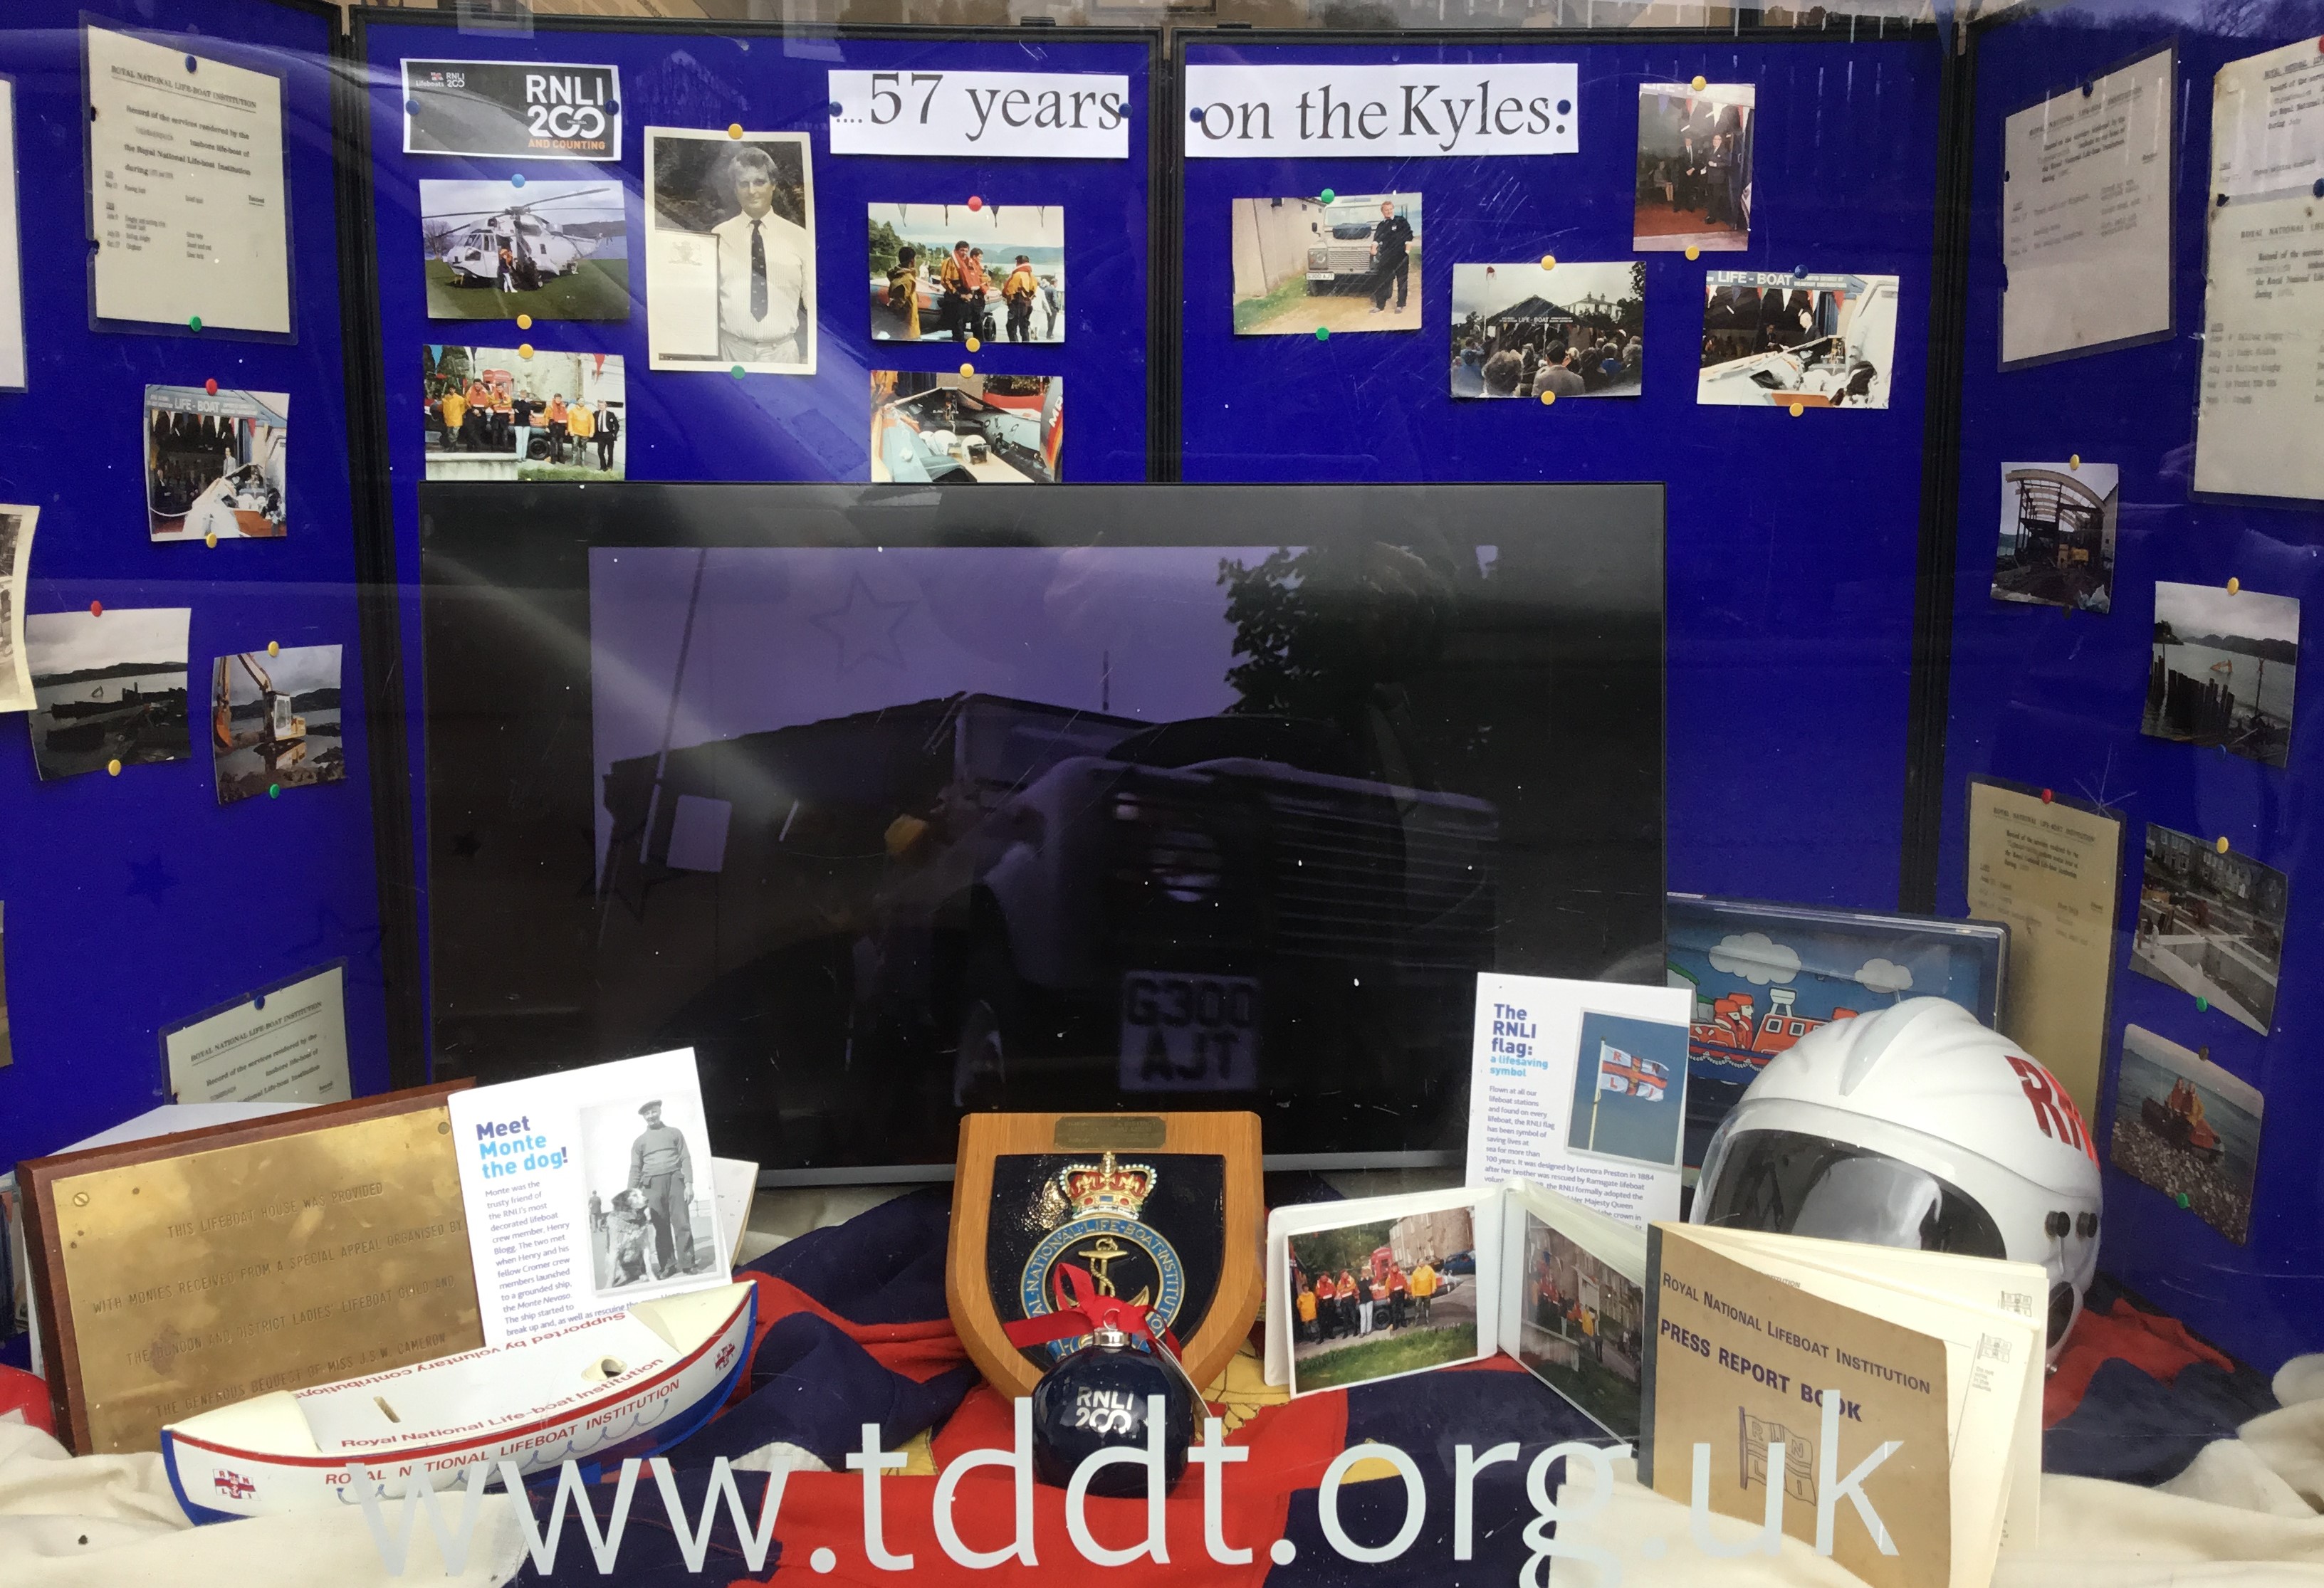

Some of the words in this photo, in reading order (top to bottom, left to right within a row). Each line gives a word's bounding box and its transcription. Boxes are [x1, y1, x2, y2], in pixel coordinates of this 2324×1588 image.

[137, 72, 173, 88] NATIONAL
[213, 92, 256, 108] INSTITUTION
[525, 74, 604, 106] RNLI
[964, 86, 1123, 142] years
[1200, 100, 1274, 141] on
[1295, 83, 1388, 140] the
[528, 139, 550, 149] AND
[553, 140, 605, 150] COUNTING
[1718, 270, 1747, 283] LIFE
[1757, 272, 1793, 286] BOAT
[174, 397, 192, 411] LIFE
[197, 400, 221, 413] BOAT
[1494, 1003, 1528, 1021] The
[214, 1032, 248, 1050] NATIONAL
[284, 1001, 322, 1022] INSTITUTION
[1492, 1020, 1537, 1039] RNLI
[1492, 1037, 1533, 1058] flag:
[1490, 1067, 1527, 1077] symbol
[1499, 1055, 1549, 1070] lifesaving
[1490, 1085, 1509, 1094] Flown
[1489, 1095, 1512, 1104] lifeboat
[1514, 1098, 1539, 1107] stations
[1501, 1106, 1519, 1115] found
[1530, 1111, 1548, 1120] every
[476, 1115, 531, 1141] Meet
[1543, 1121, 1555, 1131] flag
[479, 1135, 547, 1160] Monte
[482, 1161, 518, 1179] the
[523, 1146, 568, 1171] dog!
[1538, 1162, 1566, 1171] designed
[1576, 1166, 1602, 1174] Leonora
[1603, 1169, 1628, 1179] Preston
[1638, 1173, 1655, 1182] 1884
[485, 1187, 511, 1197] Monte
[511, 1184, 526, 1192] was
[487, 1199, 510, 1209] trusty
[511, 1193, 533, 1204] friend
[167, 1222, 194, 1239] THIS
[201, 1209, 256, 1233] LIFEBOAT
[261, 1201, 297, 1219] HOUSE
[303, 1194, 325, 1209] WAS
[332, 1182, 383, 1204] PROVIDED
[528, 1202, 548, 1213] most
[491, 1218, 528, 1232] decorated
[530, 1212, 558, 1224] lifeboat
[492, 1235, 511, 1243] crew
[547, 1222, 570, 1233] Henry
[518, 1241, 533, 1250] The
[534, 1239, 549, 1247] two
[550, 1234, 565, 1243] met
[496, 1256, 516, 1266] when
[518, 1252, 541, 1262] Henry
[543, 1247, 557, 1256] and
[558, 1245, 570, 1253] his
[93, 1297, 122, 1315] WITH
[129, 1285, 172, 1305] MONIES
[179, 1271, 235, 1295] RECEIVED
[241, 1263, 271, 1281] FROM
[277, 1260, 284, 1273] A
[290, 1249, 335, 1270] SPECIAL
[341, 1239, 382, 1258] APPEAL
[387, 1224, 445, 1247] ORGANISED
[450, 1219, 463, 1234] BY
[497, 1268, 521, 1278] fellow
[523, 1262, 550, 1273] Cromer
[553, 1257, 570, 1266] crew
[499, 1277, 535, 1290] members
[536, 1268, 570, 1282] launched
[518, 1283, 553, 1300] grounded
[126, 1349, 150, 1366] THE
[209, 1330, 232, 1345] AND
[236, 1315, 286, 1339] DISTRICT
[341, 1289, 392, 1313] LIFEBOAT
[398, 1281, 429, 1300] GUILD
[435, 1275, 455, 1290] AND
[532, 1312, 626, 1345] Supported
[1662, 1271, 1700, 1303] ROYAL
[1703, 1290, 1762, 1332] NATIONAL
[1767, 1320, 1830, 1359] LIFEBOAT
[1836, 1347, 1931, 1395] INSTITUTION
[505, 1340, 528, 1352] by
[1660, 1319, 1711, 1358] PRESS
[1718, 1347, 1791, 1394] REPORT
[417, 1346, 501, 1374] voluntary
[155, 1401, 179, 1419] THE
[185, 1384, 246, 1411] GENEROUS
[251, 1369, 303, 1394] BEQUEST
[328, 1357, 353, 1374] MISS
[397, 1332, 446, 1357] CAMERON
[293, 1367, 414, 1401] contributions
[341, 1434, 397, 1449] Royal
[400, 1416, 481, 1444] National
[488, 1394, 575, 1426] Life-boat
[575, 1357, 665, 1401] Institution
[1076, 1386, 1134, 1410] RNLI
[325, 1471, 387, 1486] ROAL
[398, 1449, 490, 1479] NTIONAL
[500, 1424, 578, 1457] LIFEBOAT
[585, 1379, 681, 1431] INSTITUTION
[345, 1389, 1905, 1588] www.tddt.org.uk
